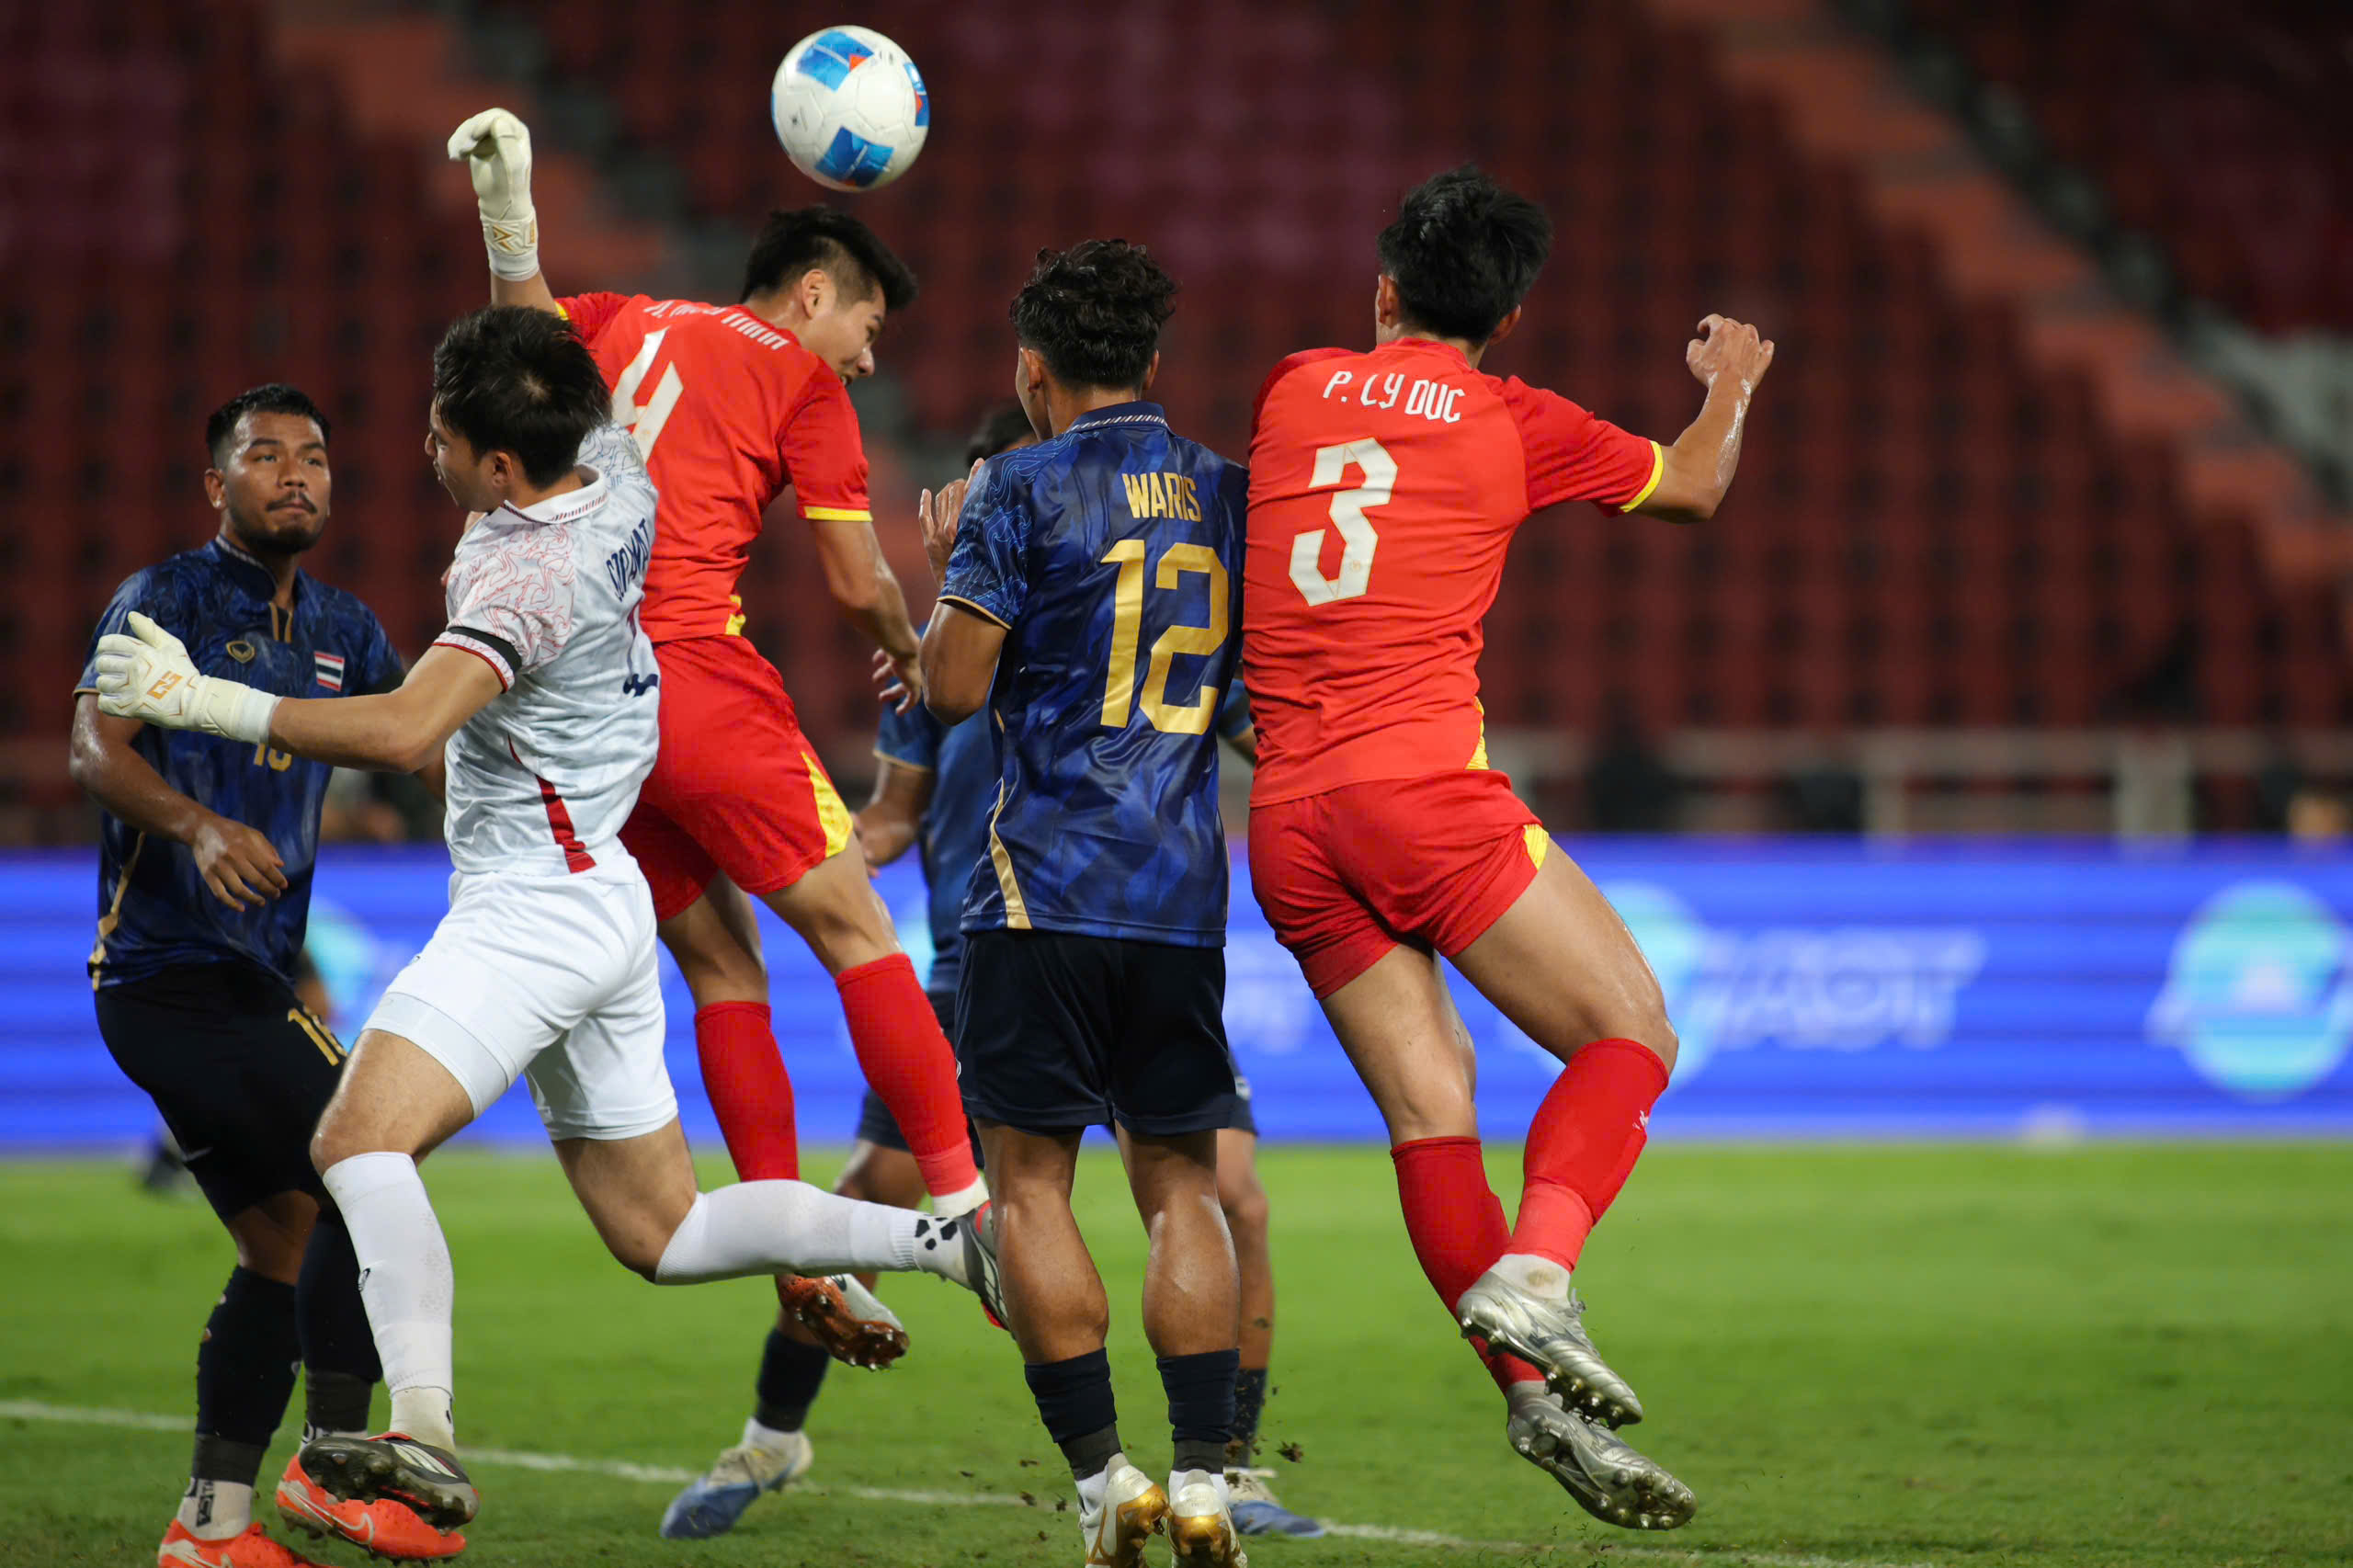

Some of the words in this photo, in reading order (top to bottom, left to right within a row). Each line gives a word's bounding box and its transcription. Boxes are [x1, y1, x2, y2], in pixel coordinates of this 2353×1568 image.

[610, 325, 684, 464] 4
[1323, 370, 1353, 403] P.
[1359, 373, 1405, 409] LY
[1404, 379, 1465, 424] DUC
[1121, 472, 1202, 523] WARIS
[1289, 437, 1399, 607] 3
[1099, 539, 1229, 736] 12
